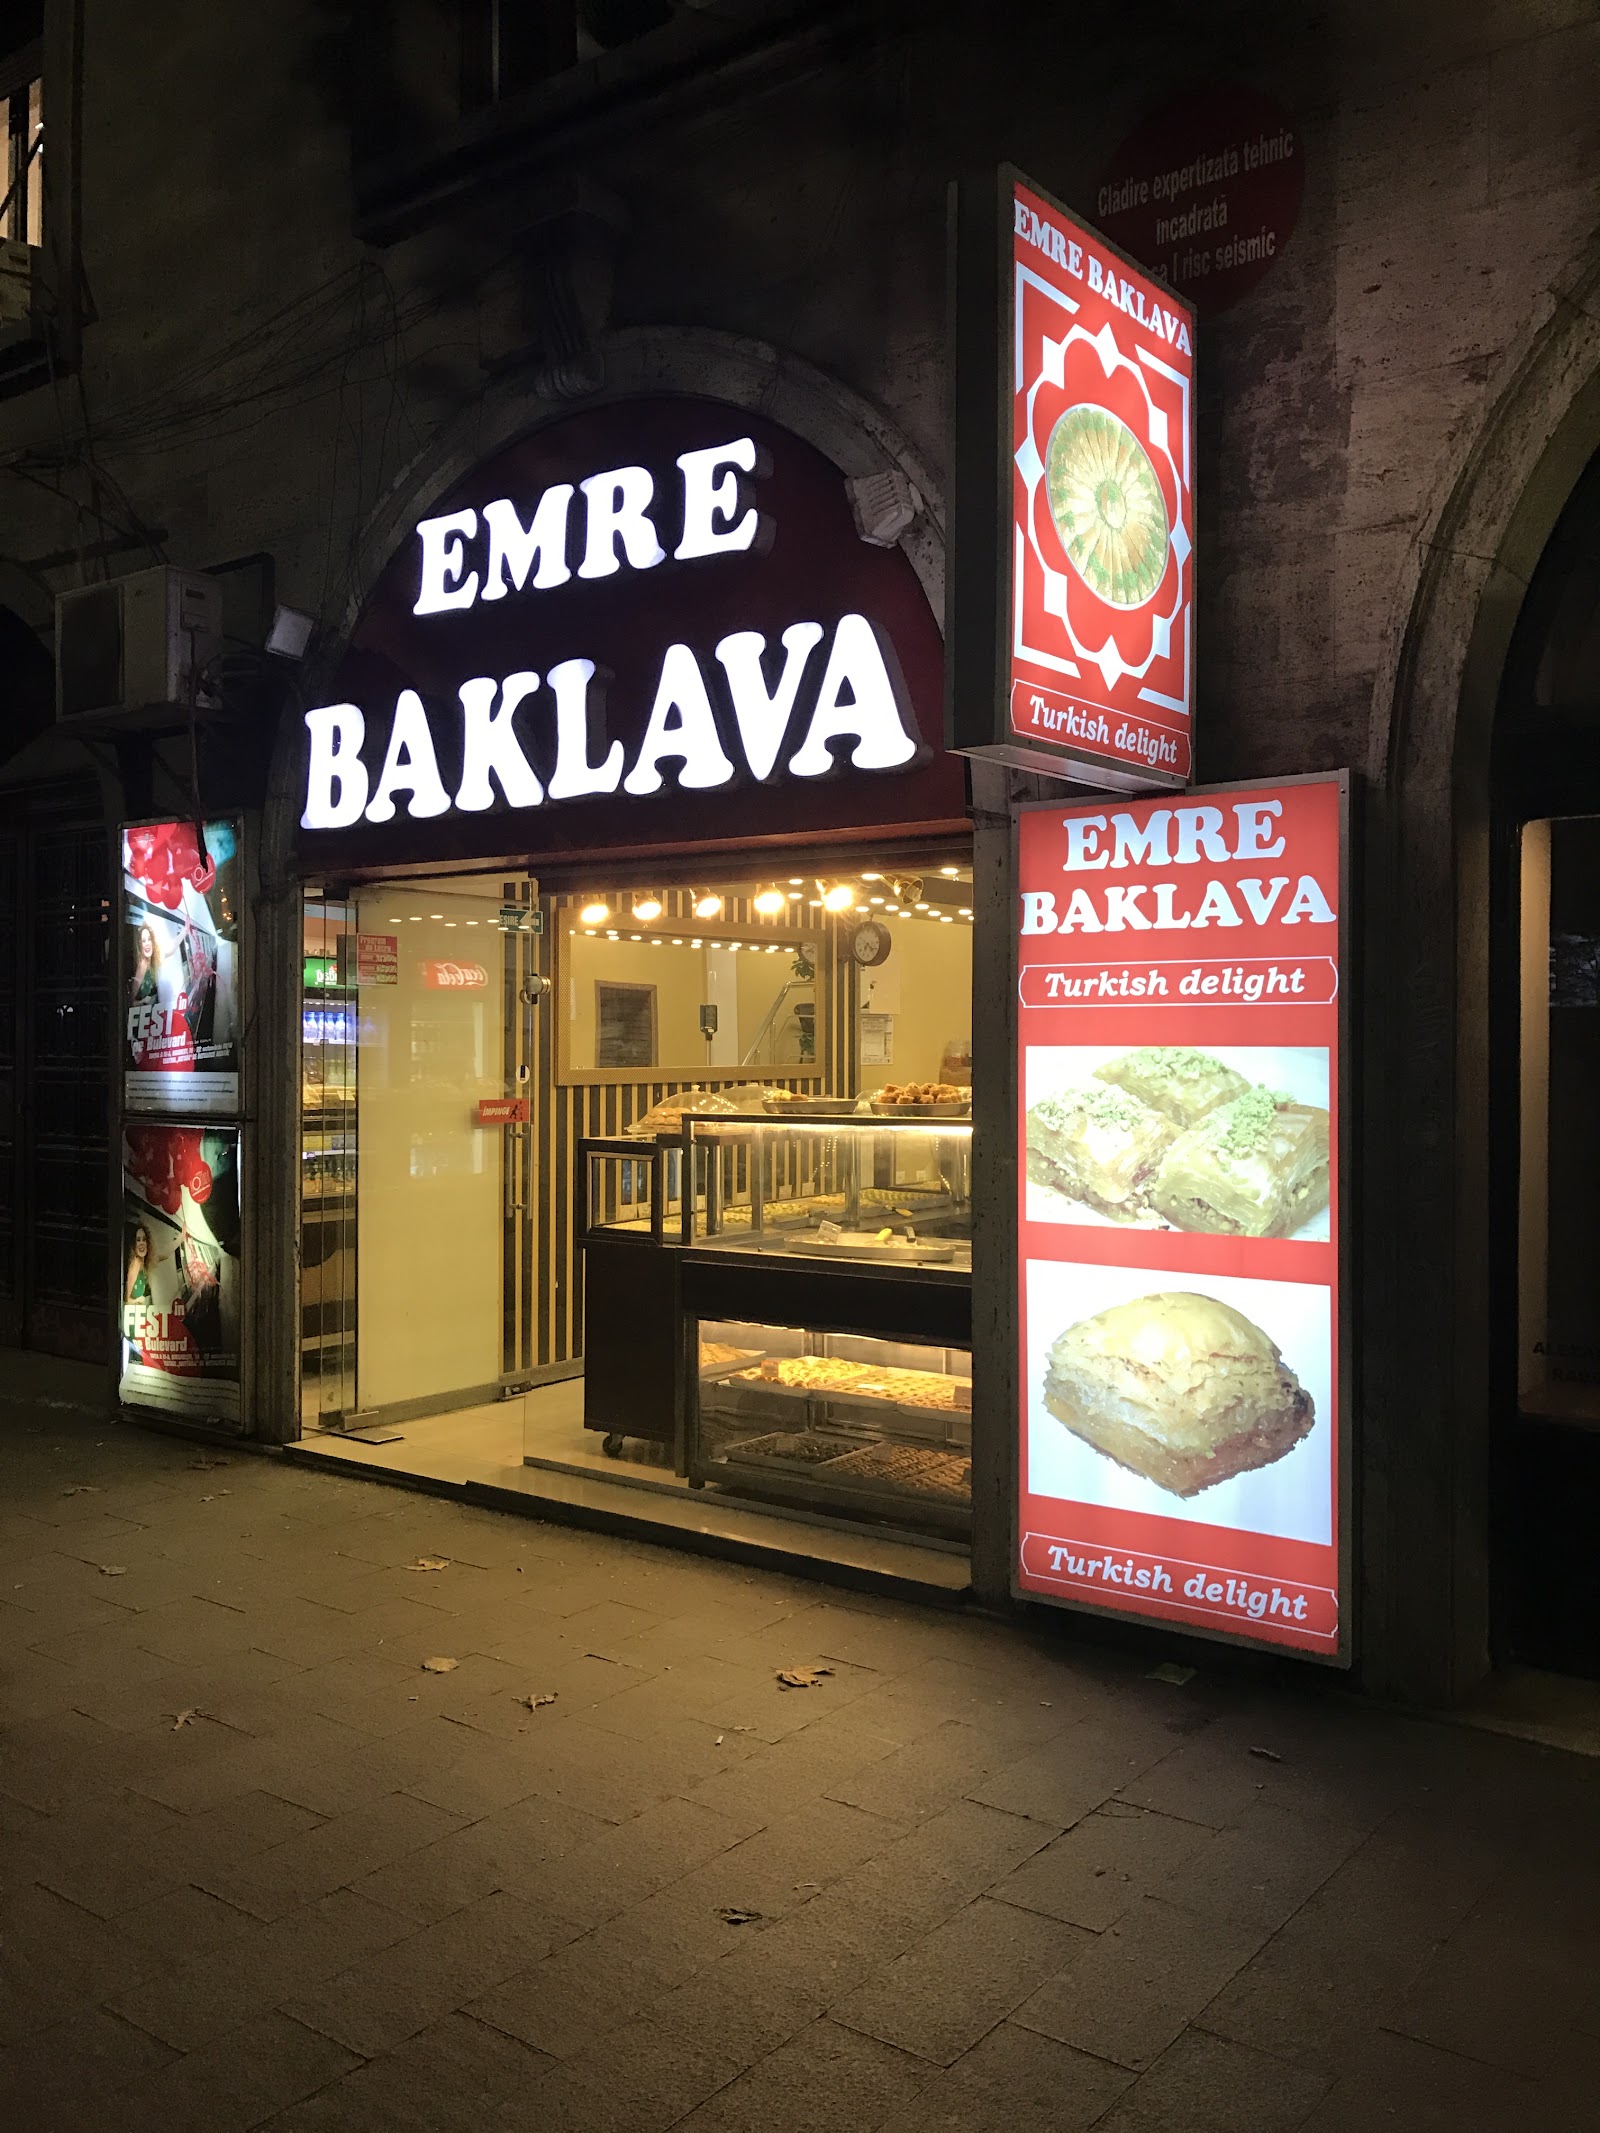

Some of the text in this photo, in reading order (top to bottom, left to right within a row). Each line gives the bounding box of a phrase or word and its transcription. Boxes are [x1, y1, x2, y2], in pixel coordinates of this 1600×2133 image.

[1243, 127, 1294, 171] tehnic
[1013, 198, 1192, 356] EMRE BAKLAVA
[1182, 248, 1211, 280] risc
[1215, 225, 1276, 270] seismic
[412, 437, 757, 616] EMRE
[300, 612, 917, 830] BAKLAVA
[1029, 694, 1178, 765] Turkish delight
[1063, 799, 1286, 871] EMRE
[1020, 874, 1337, 935] BAKLAVA
[1044, 966, 1306, 1002] Turkish delight
[127, 1002, 174, 1041] FEST
[146, 1031, 187, 1052] Bulevard
[123, 1304, 169, 1338] FEST
[145, 1336, 188, 1352] Bulevard
[1047, 1544, 1308, 1620] Turkish delight
